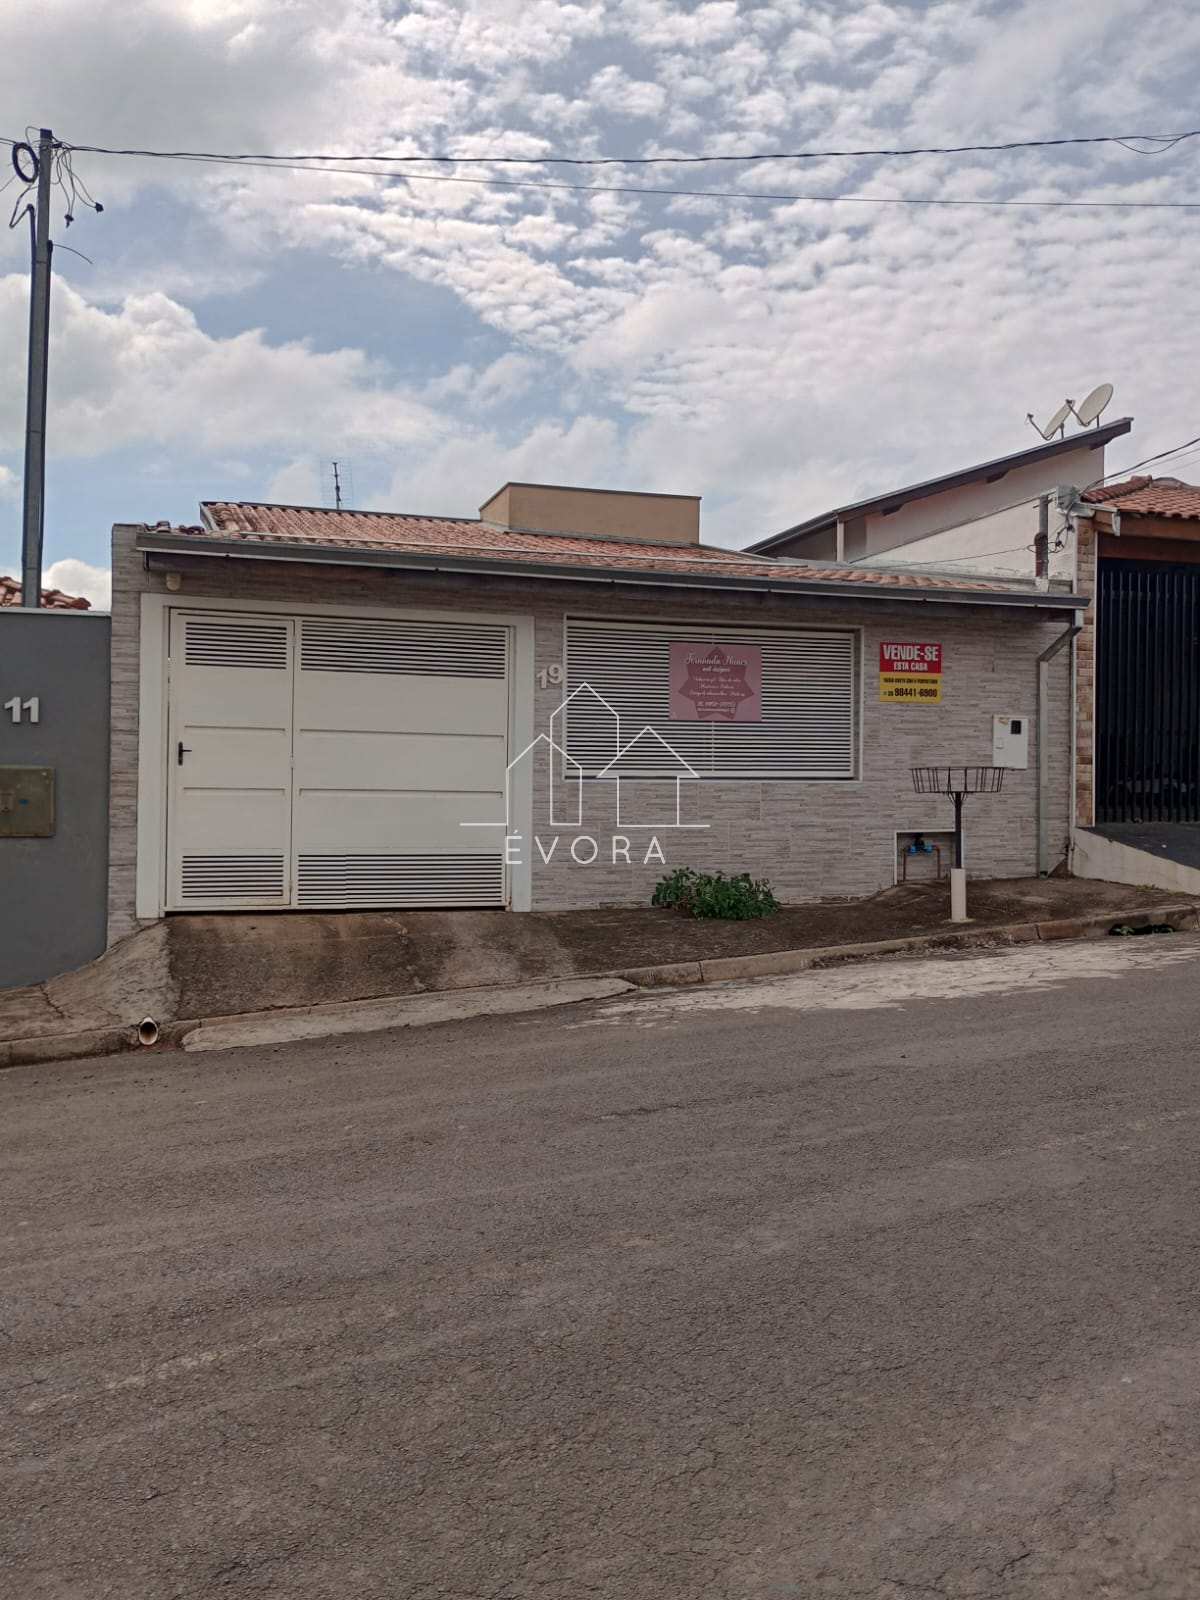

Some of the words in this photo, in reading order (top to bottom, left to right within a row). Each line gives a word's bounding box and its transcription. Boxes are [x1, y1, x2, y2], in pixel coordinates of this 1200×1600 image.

[883, 644, 940, 662] VENDE-SE
[536, 664, 563, 688] 19
[893, 661, 909, 671] ESTA
[4, 697, 40, 723] 11
